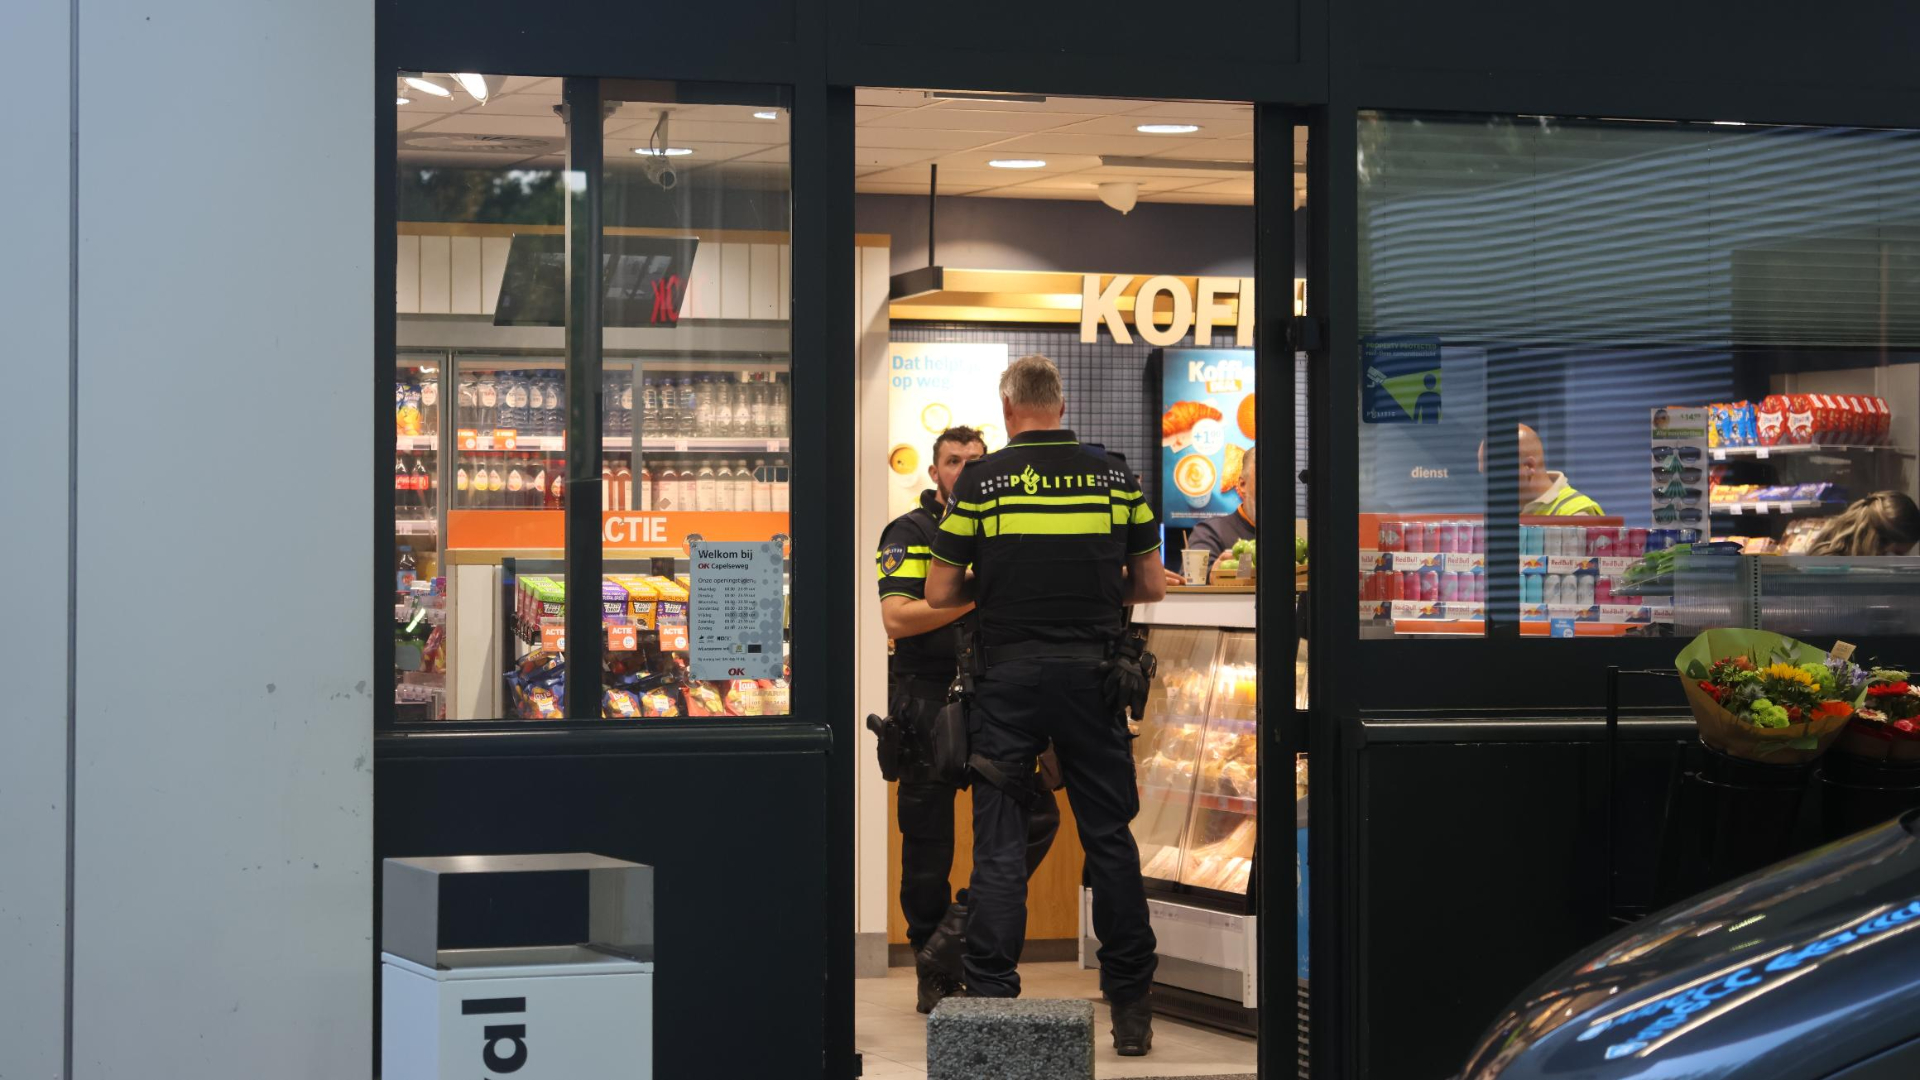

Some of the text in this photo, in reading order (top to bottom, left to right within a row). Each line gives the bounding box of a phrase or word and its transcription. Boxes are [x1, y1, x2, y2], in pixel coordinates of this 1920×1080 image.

[892, 355, 919, 370] Dat
[892, 375, 912, 390] op
[1411, 466, 1449, 478] dienst
[1010, 470, 1096, 494] POLITIE
[602, 516, 667, 543] CTIE
[698, 549, 753, 561] Welkom bij
[663, 627, 684, 635] ACTIE
[728, 667, 745, 676] OK
[462, 997, 527, 1080] al
